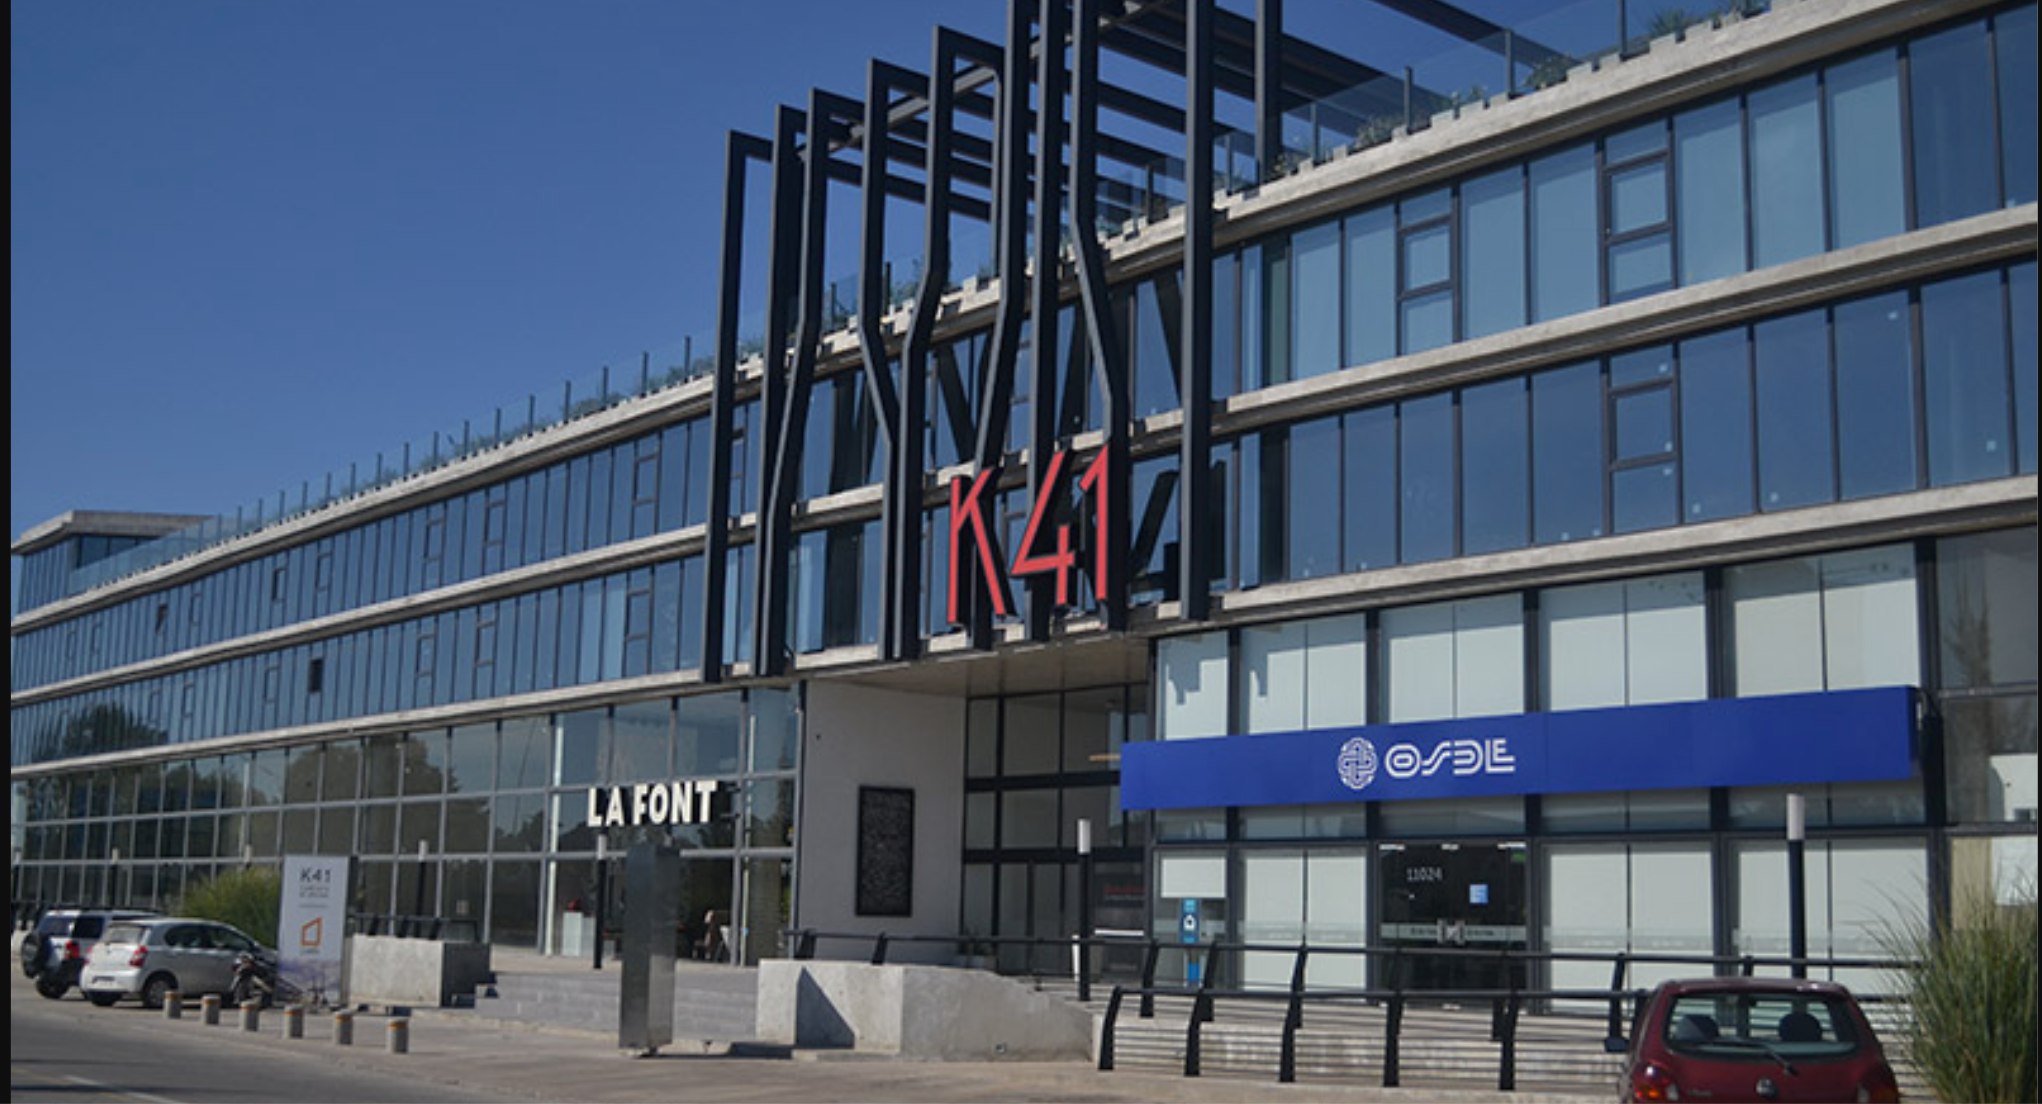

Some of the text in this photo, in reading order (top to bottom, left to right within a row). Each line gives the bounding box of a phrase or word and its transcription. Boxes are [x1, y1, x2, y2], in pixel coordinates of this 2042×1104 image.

[947, 444, 1108, 623] K41
[1385, 738, 1515, 778] OSDE
[587, 780, 717, 827] LA FONT
[300, 867, 331, 882] K41
[1406, 867, 1442, 881] 11024
